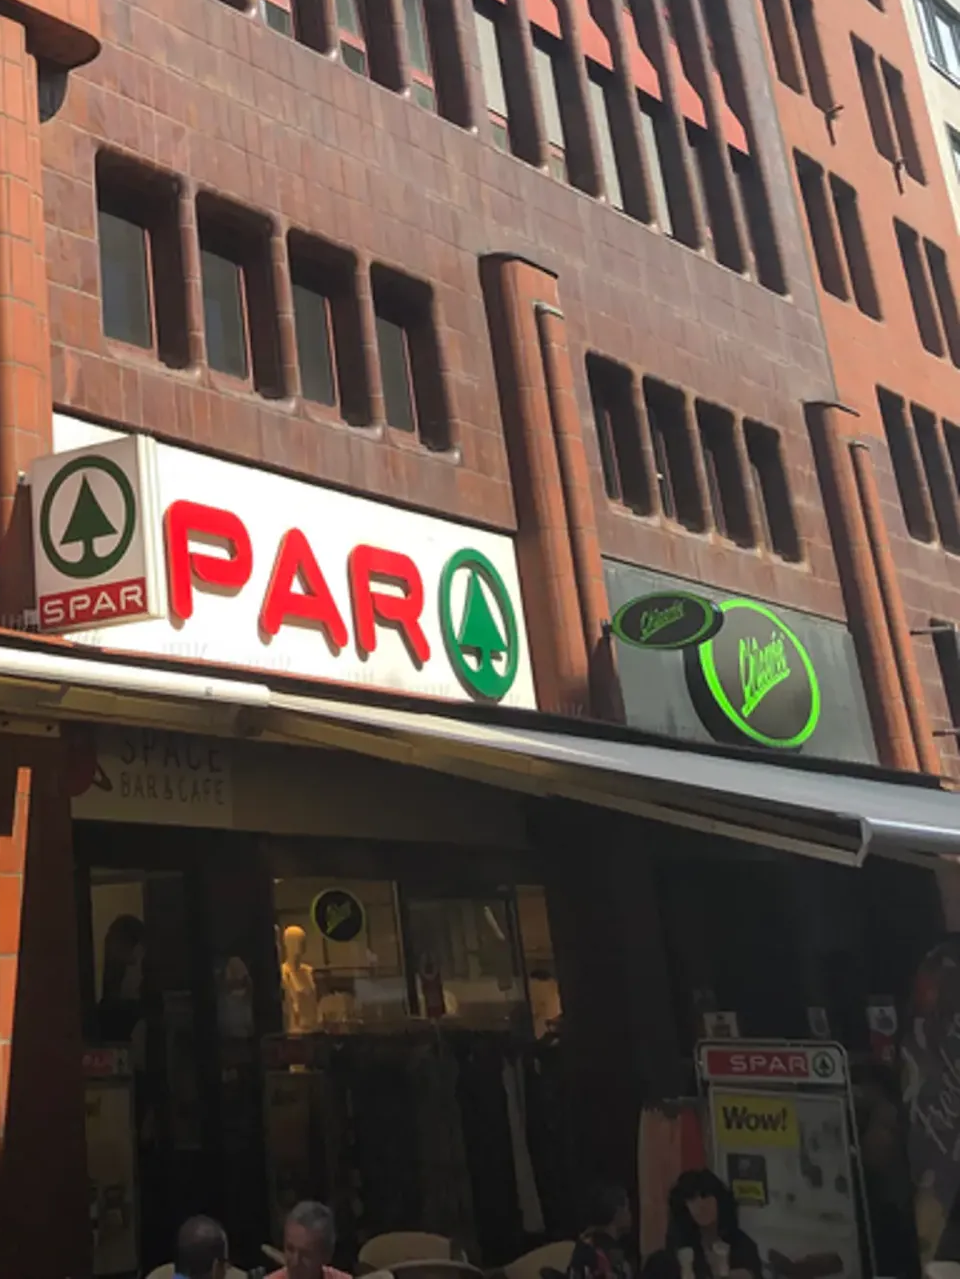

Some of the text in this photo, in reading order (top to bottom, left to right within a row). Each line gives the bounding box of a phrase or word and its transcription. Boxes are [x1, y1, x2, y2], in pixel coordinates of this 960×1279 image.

[163, 498, 431, 664] PAR
[43, 584, 144, 624] SPAR
[729, 1054, 809, 1073] SPAR
[722, 1105, 788, 1132] Wow!
